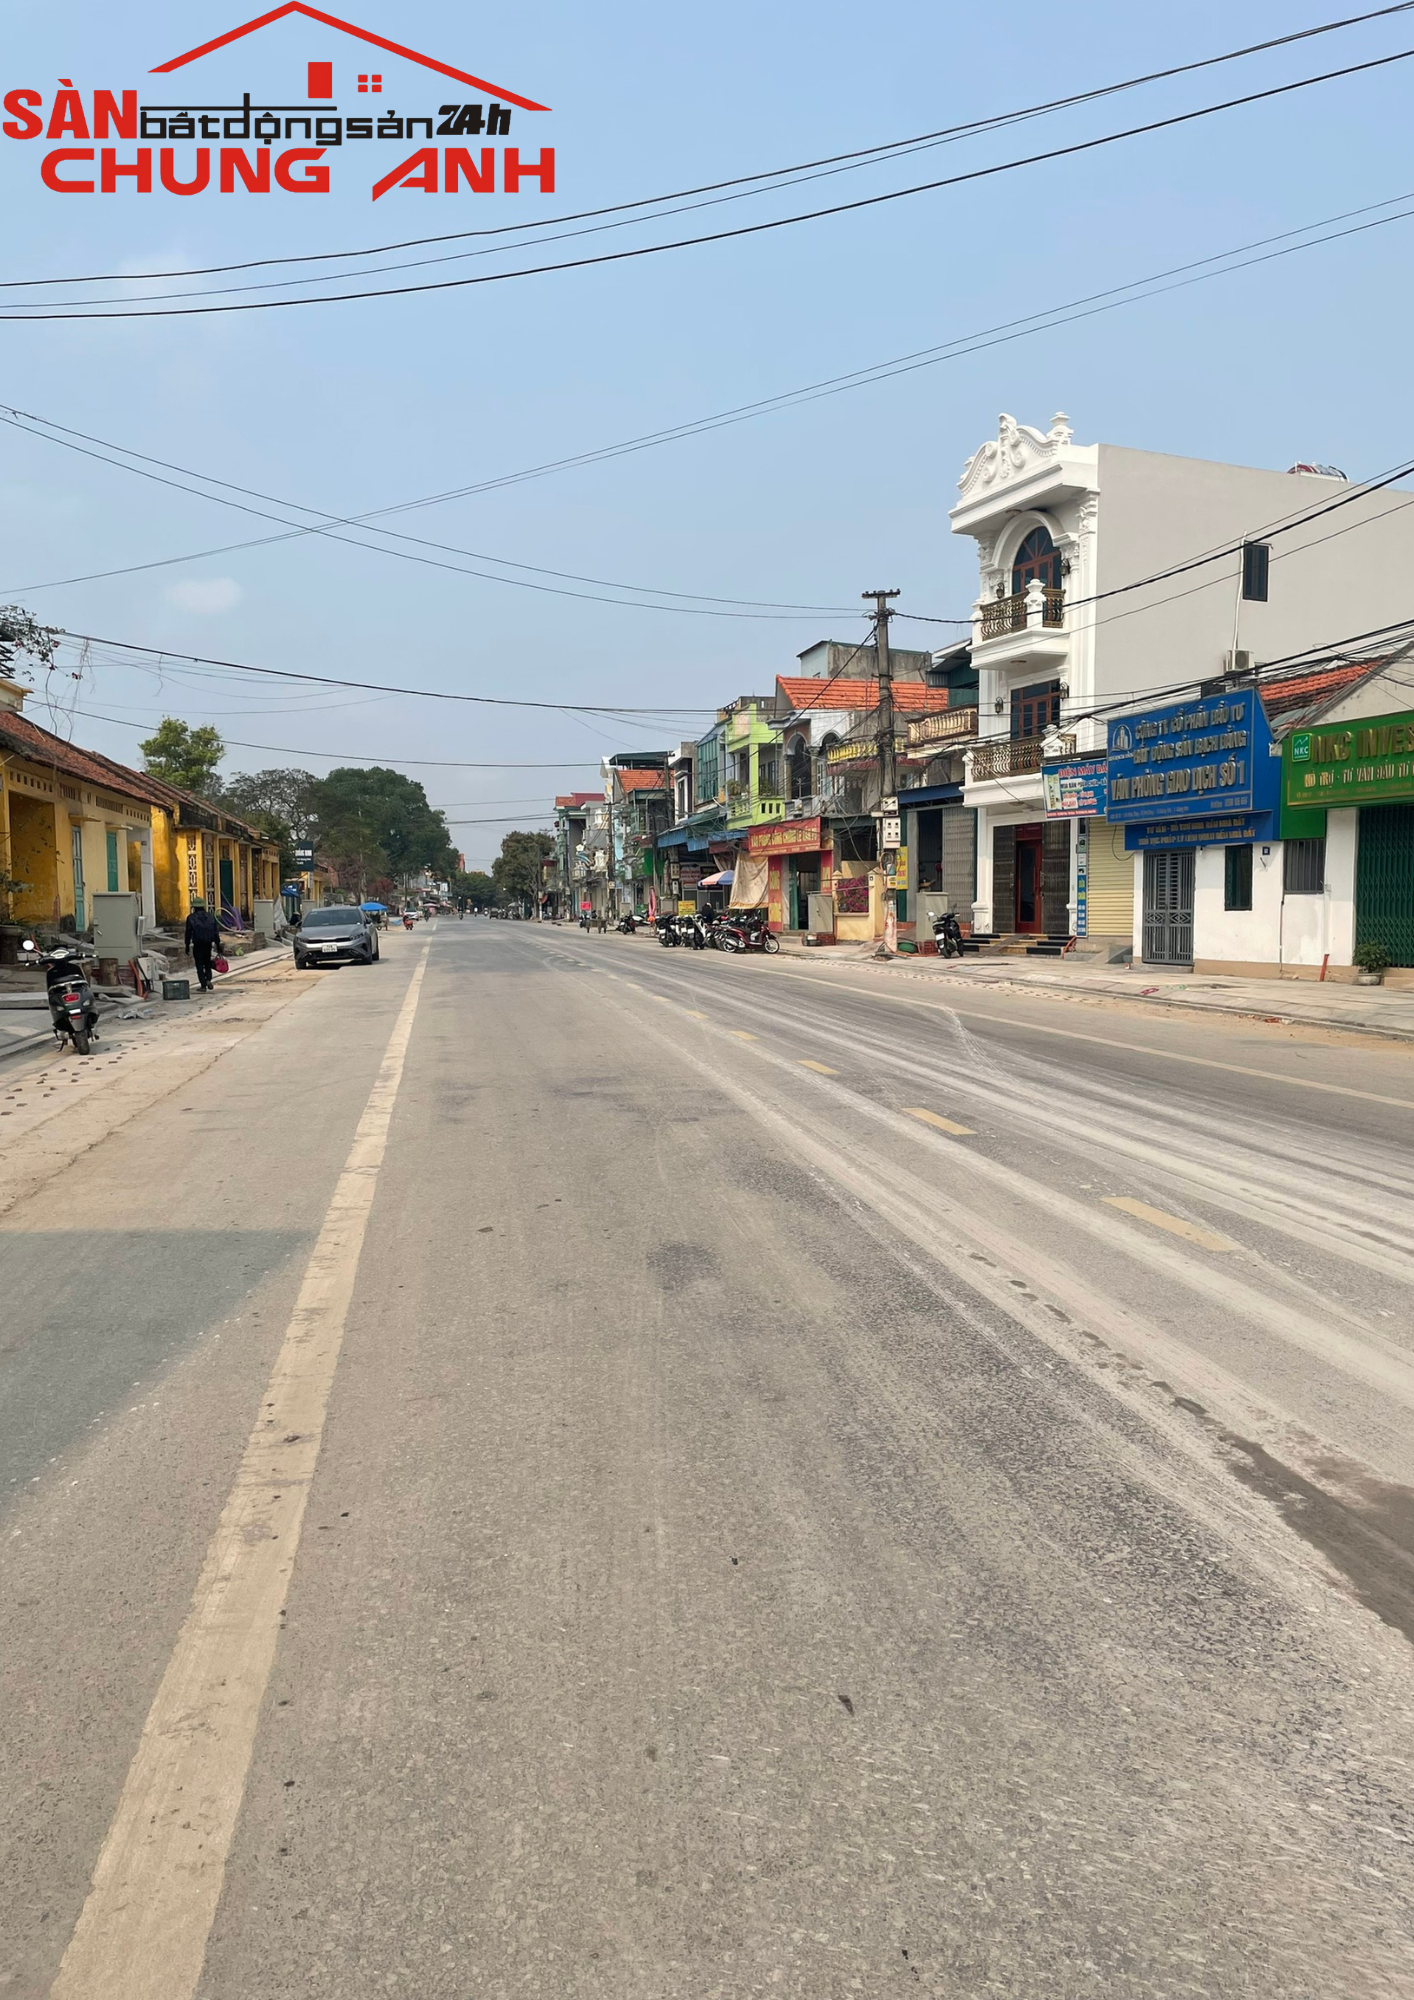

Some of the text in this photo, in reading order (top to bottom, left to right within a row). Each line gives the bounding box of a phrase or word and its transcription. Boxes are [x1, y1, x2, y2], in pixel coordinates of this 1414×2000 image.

[1294, 746, 1309, 755] NKC
[1313, 731, 1352, 763] NKC
[1077, 763, 1095, 776] MÁY
[1131, 769, 1164, 798] PHÒNG
[1166, 768, 1190, 794] GIAO
[1192, 764, 1217, 795] DỊCH
[1220, 752, 1236, 787] SỐ
[1237, 760, 1245, 784] 1
